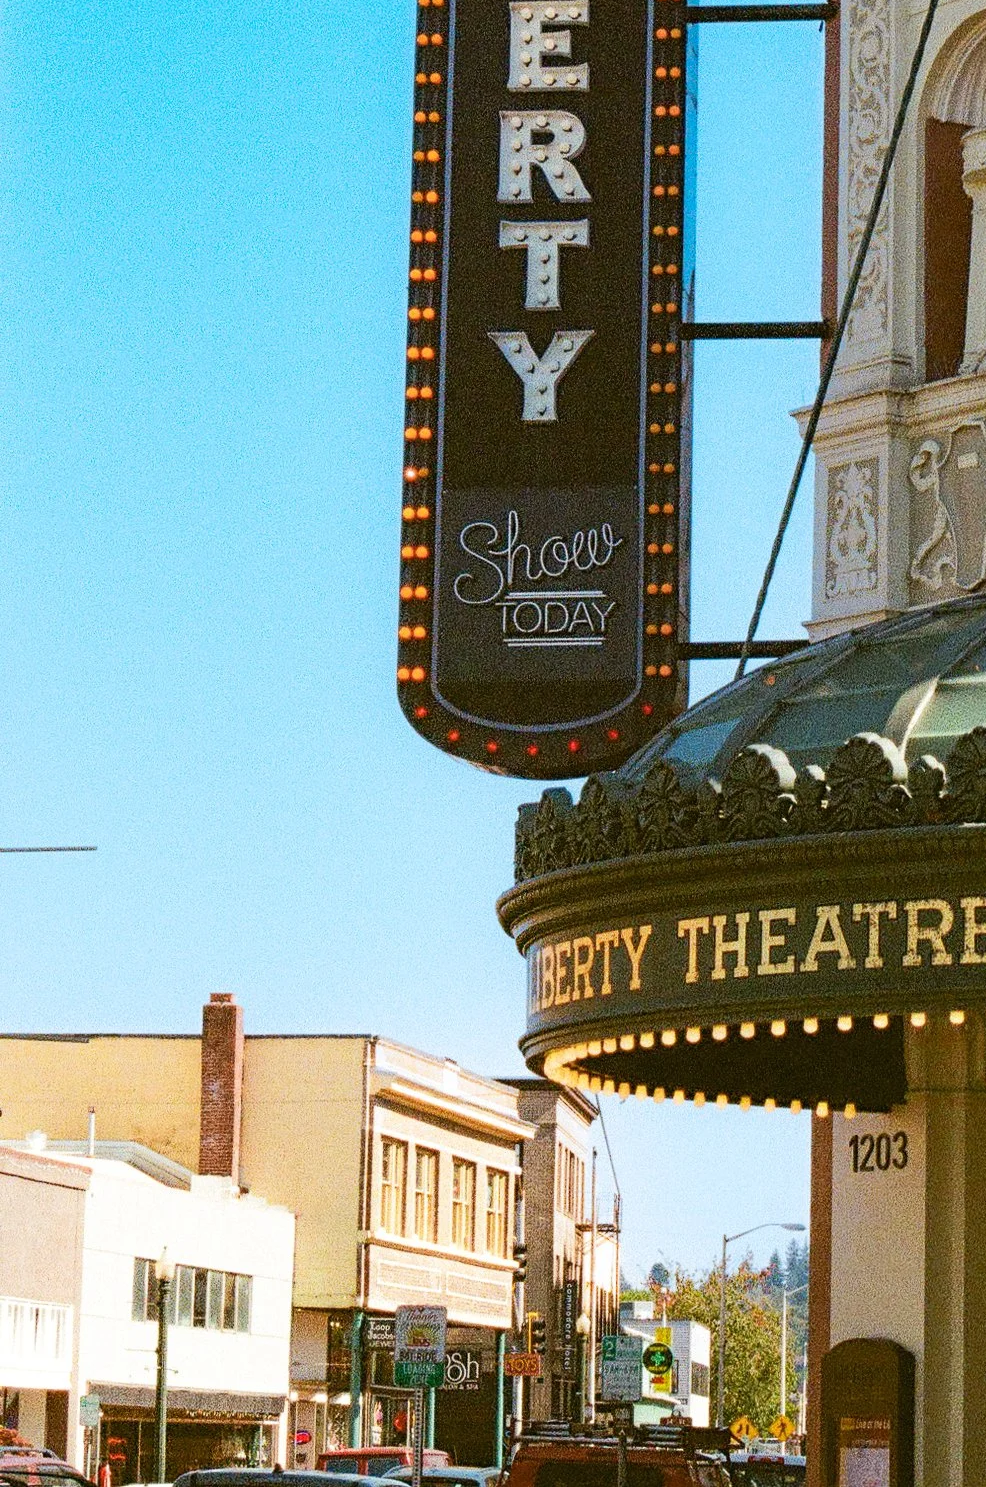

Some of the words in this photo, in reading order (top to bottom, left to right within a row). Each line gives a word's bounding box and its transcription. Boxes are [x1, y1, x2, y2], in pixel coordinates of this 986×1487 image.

[454, 510, 623, 604] Show
[495, 601, 616, 633] TODAY
[849, 1130, 908, 1173] 1203
[508, 1359, 537, 1371] TOYS
